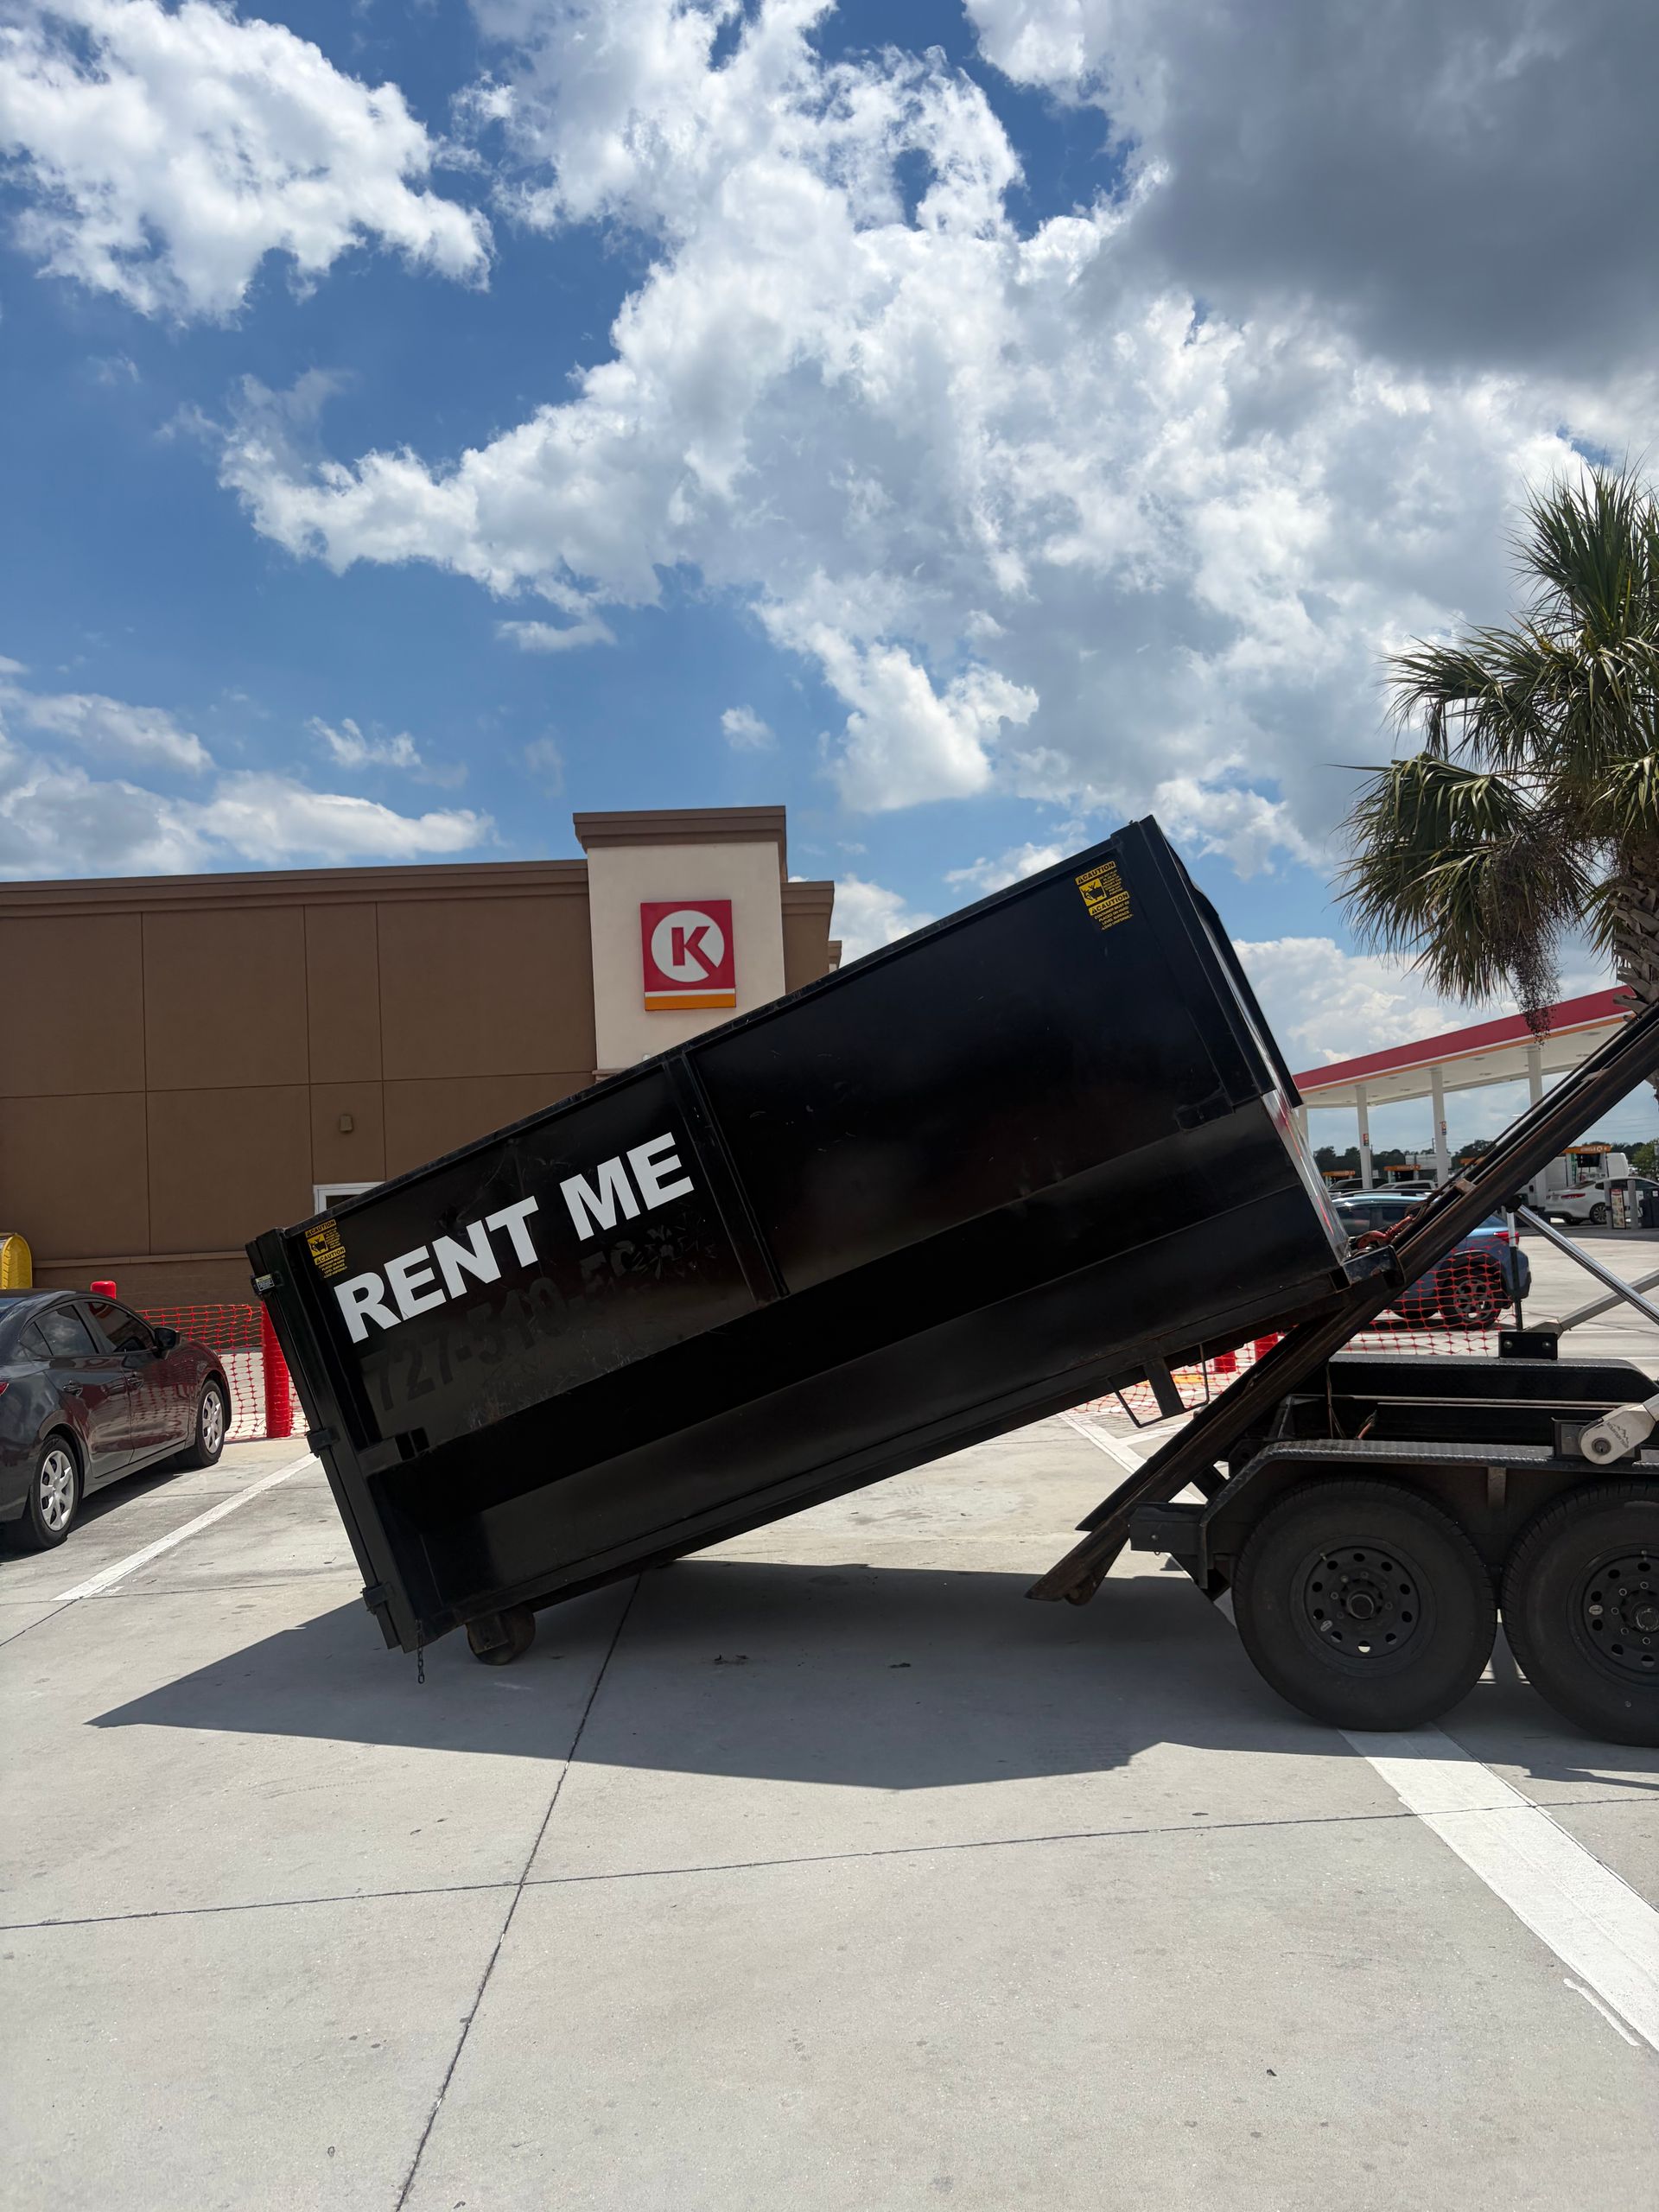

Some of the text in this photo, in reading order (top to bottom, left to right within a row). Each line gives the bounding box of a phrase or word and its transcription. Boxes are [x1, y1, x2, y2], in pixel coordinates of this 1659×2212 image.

[1082, 861, 1115, 880] CAUTION
[1096, 893, 1128, 911] CAUTION
[310, 1220, 335, 1234] CAUTION
[334, 1132, 695, 1344] RENT ME
[320, 1247, 345, 1262] CAUTION
